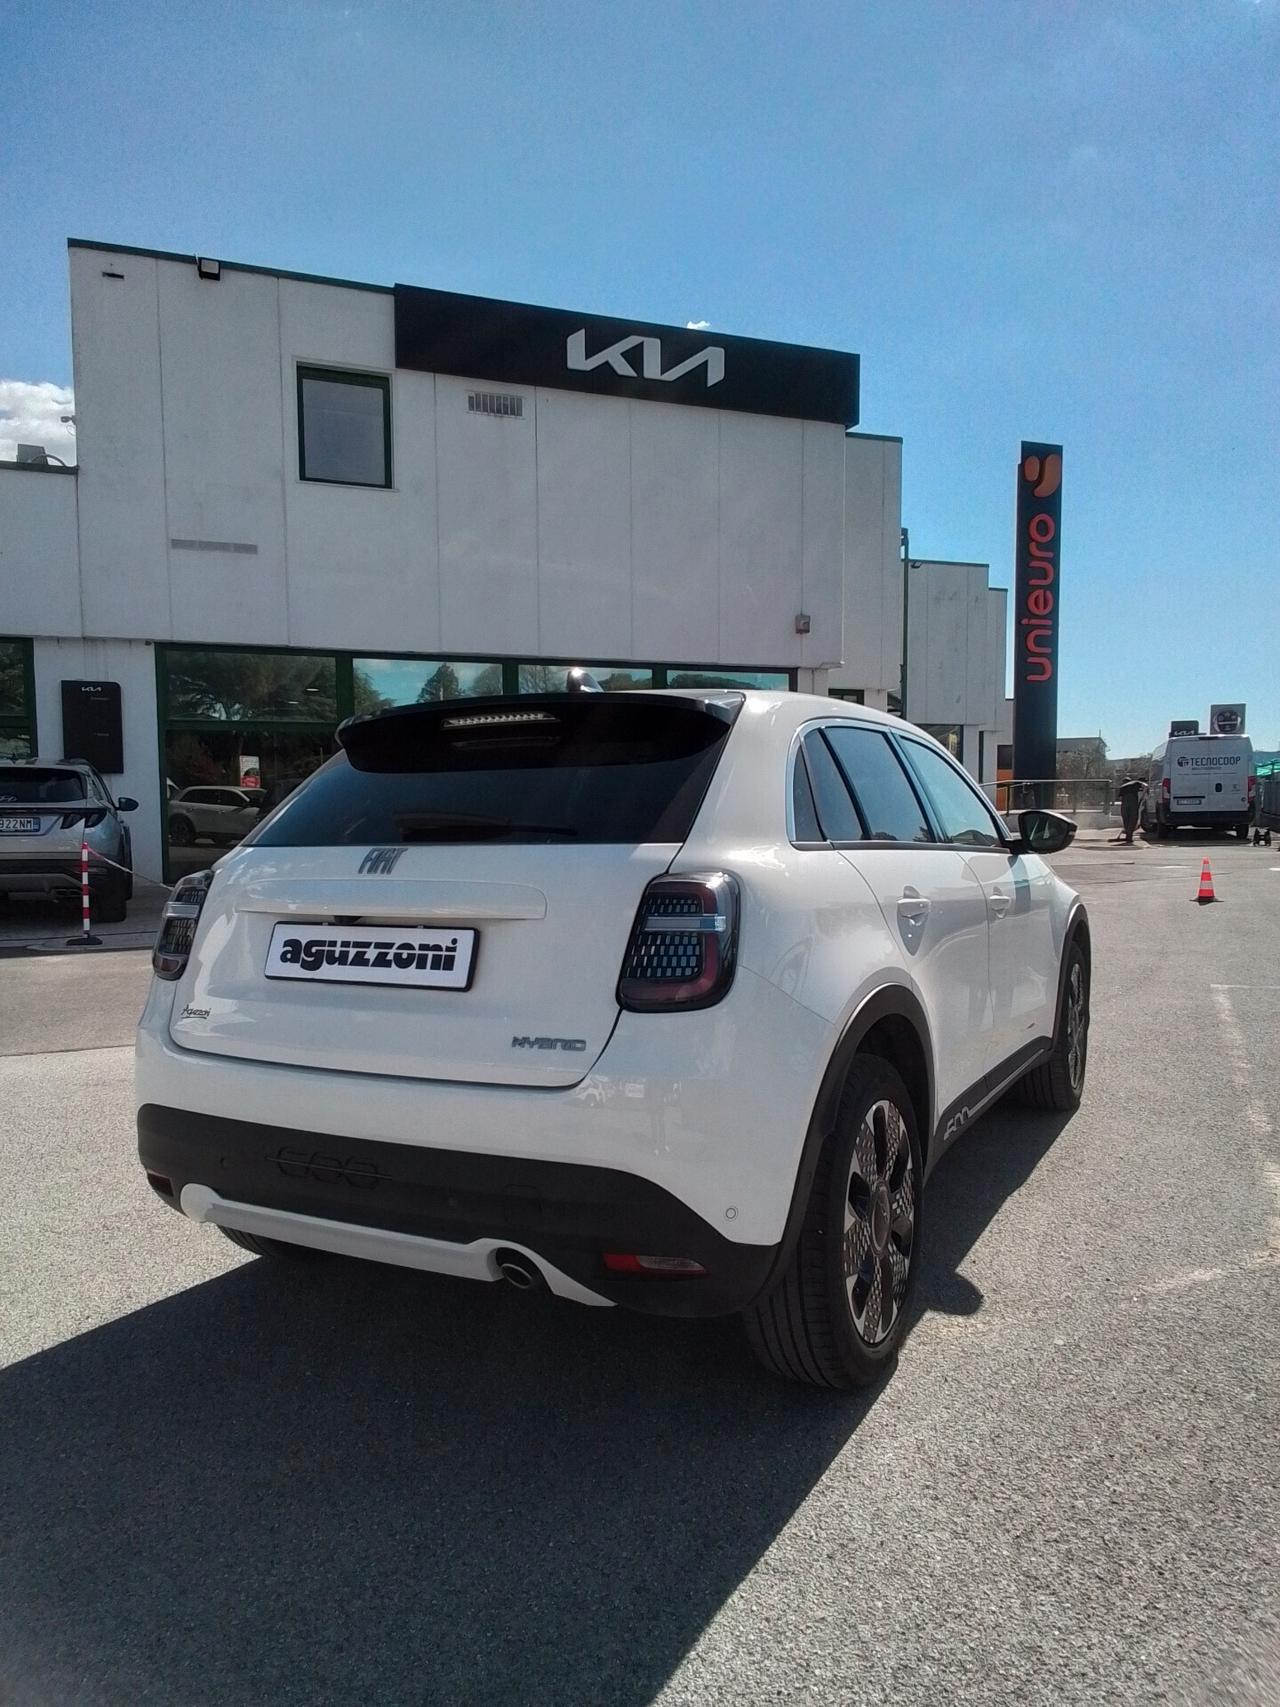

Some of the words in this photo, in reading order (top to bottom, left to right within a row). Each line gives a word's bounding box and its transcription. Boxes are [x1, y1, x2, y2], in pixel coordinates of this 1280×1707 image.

[566, 327, 726, 388] KIA
[1020, 512, 1056, 682] unieuro
[1190, 756, 1241, 766] TECNOCOOP
[357, 847, 409, 875] FIAT
[279, 937, 459, 972] aguzzoni
[511, 1036, 587, 1052] HYBRID
